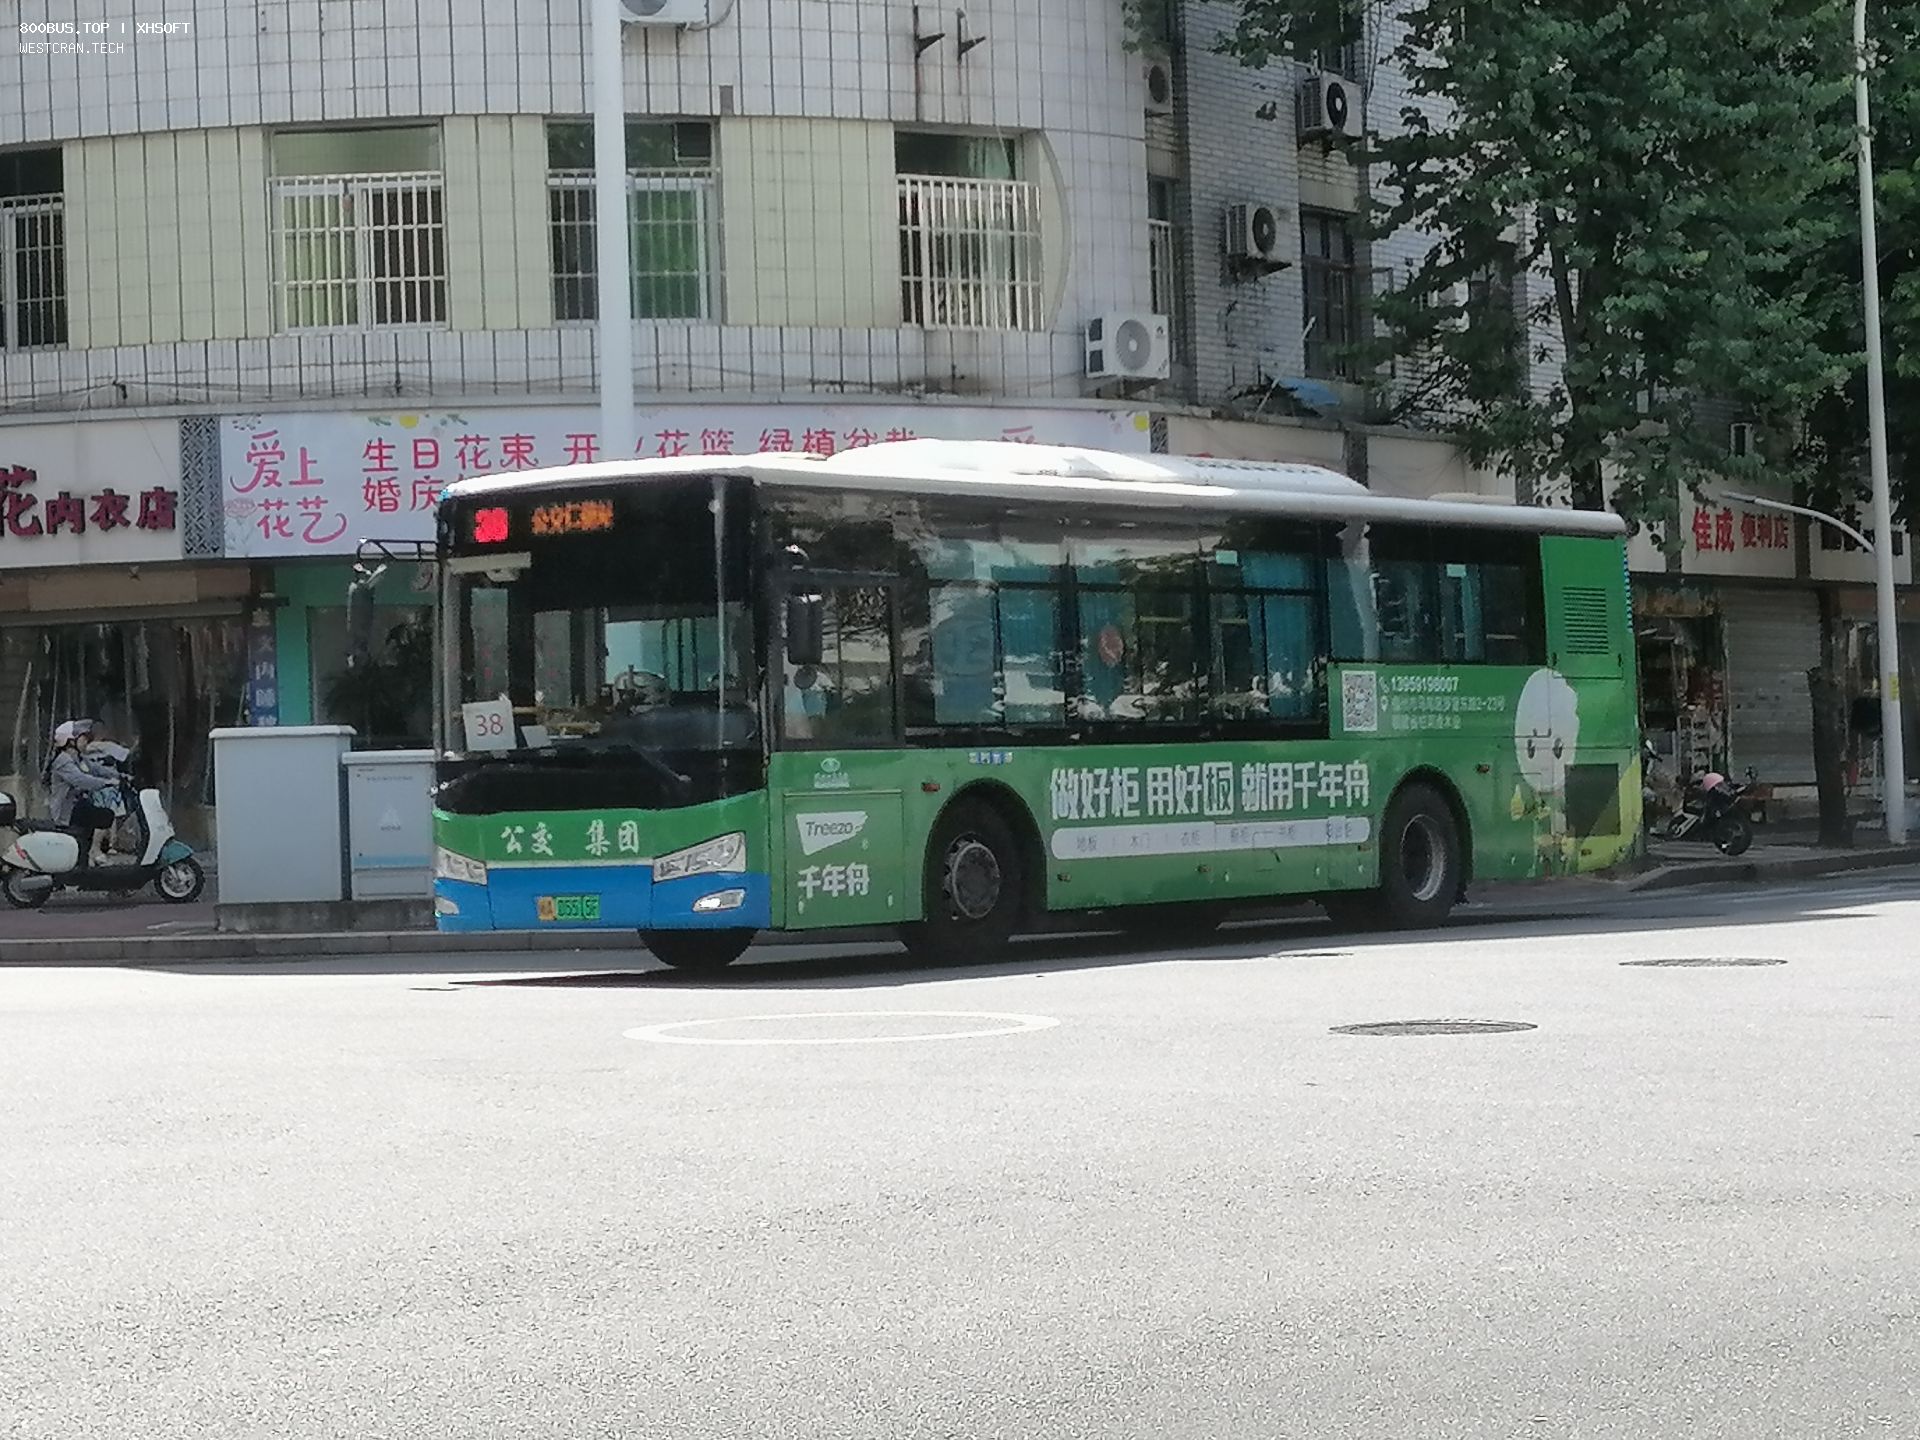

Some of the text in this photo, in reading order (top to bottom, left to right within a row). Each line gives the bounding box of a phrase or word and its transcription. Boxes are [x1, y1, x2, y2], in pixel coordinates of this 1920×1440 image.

[229, 429, 325, 493] 爱上
[362, 433, 539, 470] 生日花束
[563, 427, 735, 464] 开花篮
[257, 495, 348, 544] 花艺
[1691, 506, 1735, 552] 佳成
[474, 713, 504, 738] 38
[1051, 767, 1141, 820] 做好柜
[1241, 760, 1370, 813] 就用千年舟
[501, 819, 639, 856] 公交 集团
[805, 821, 854, 837] Treezo
[797, 862, 869, 899] 千年舟
